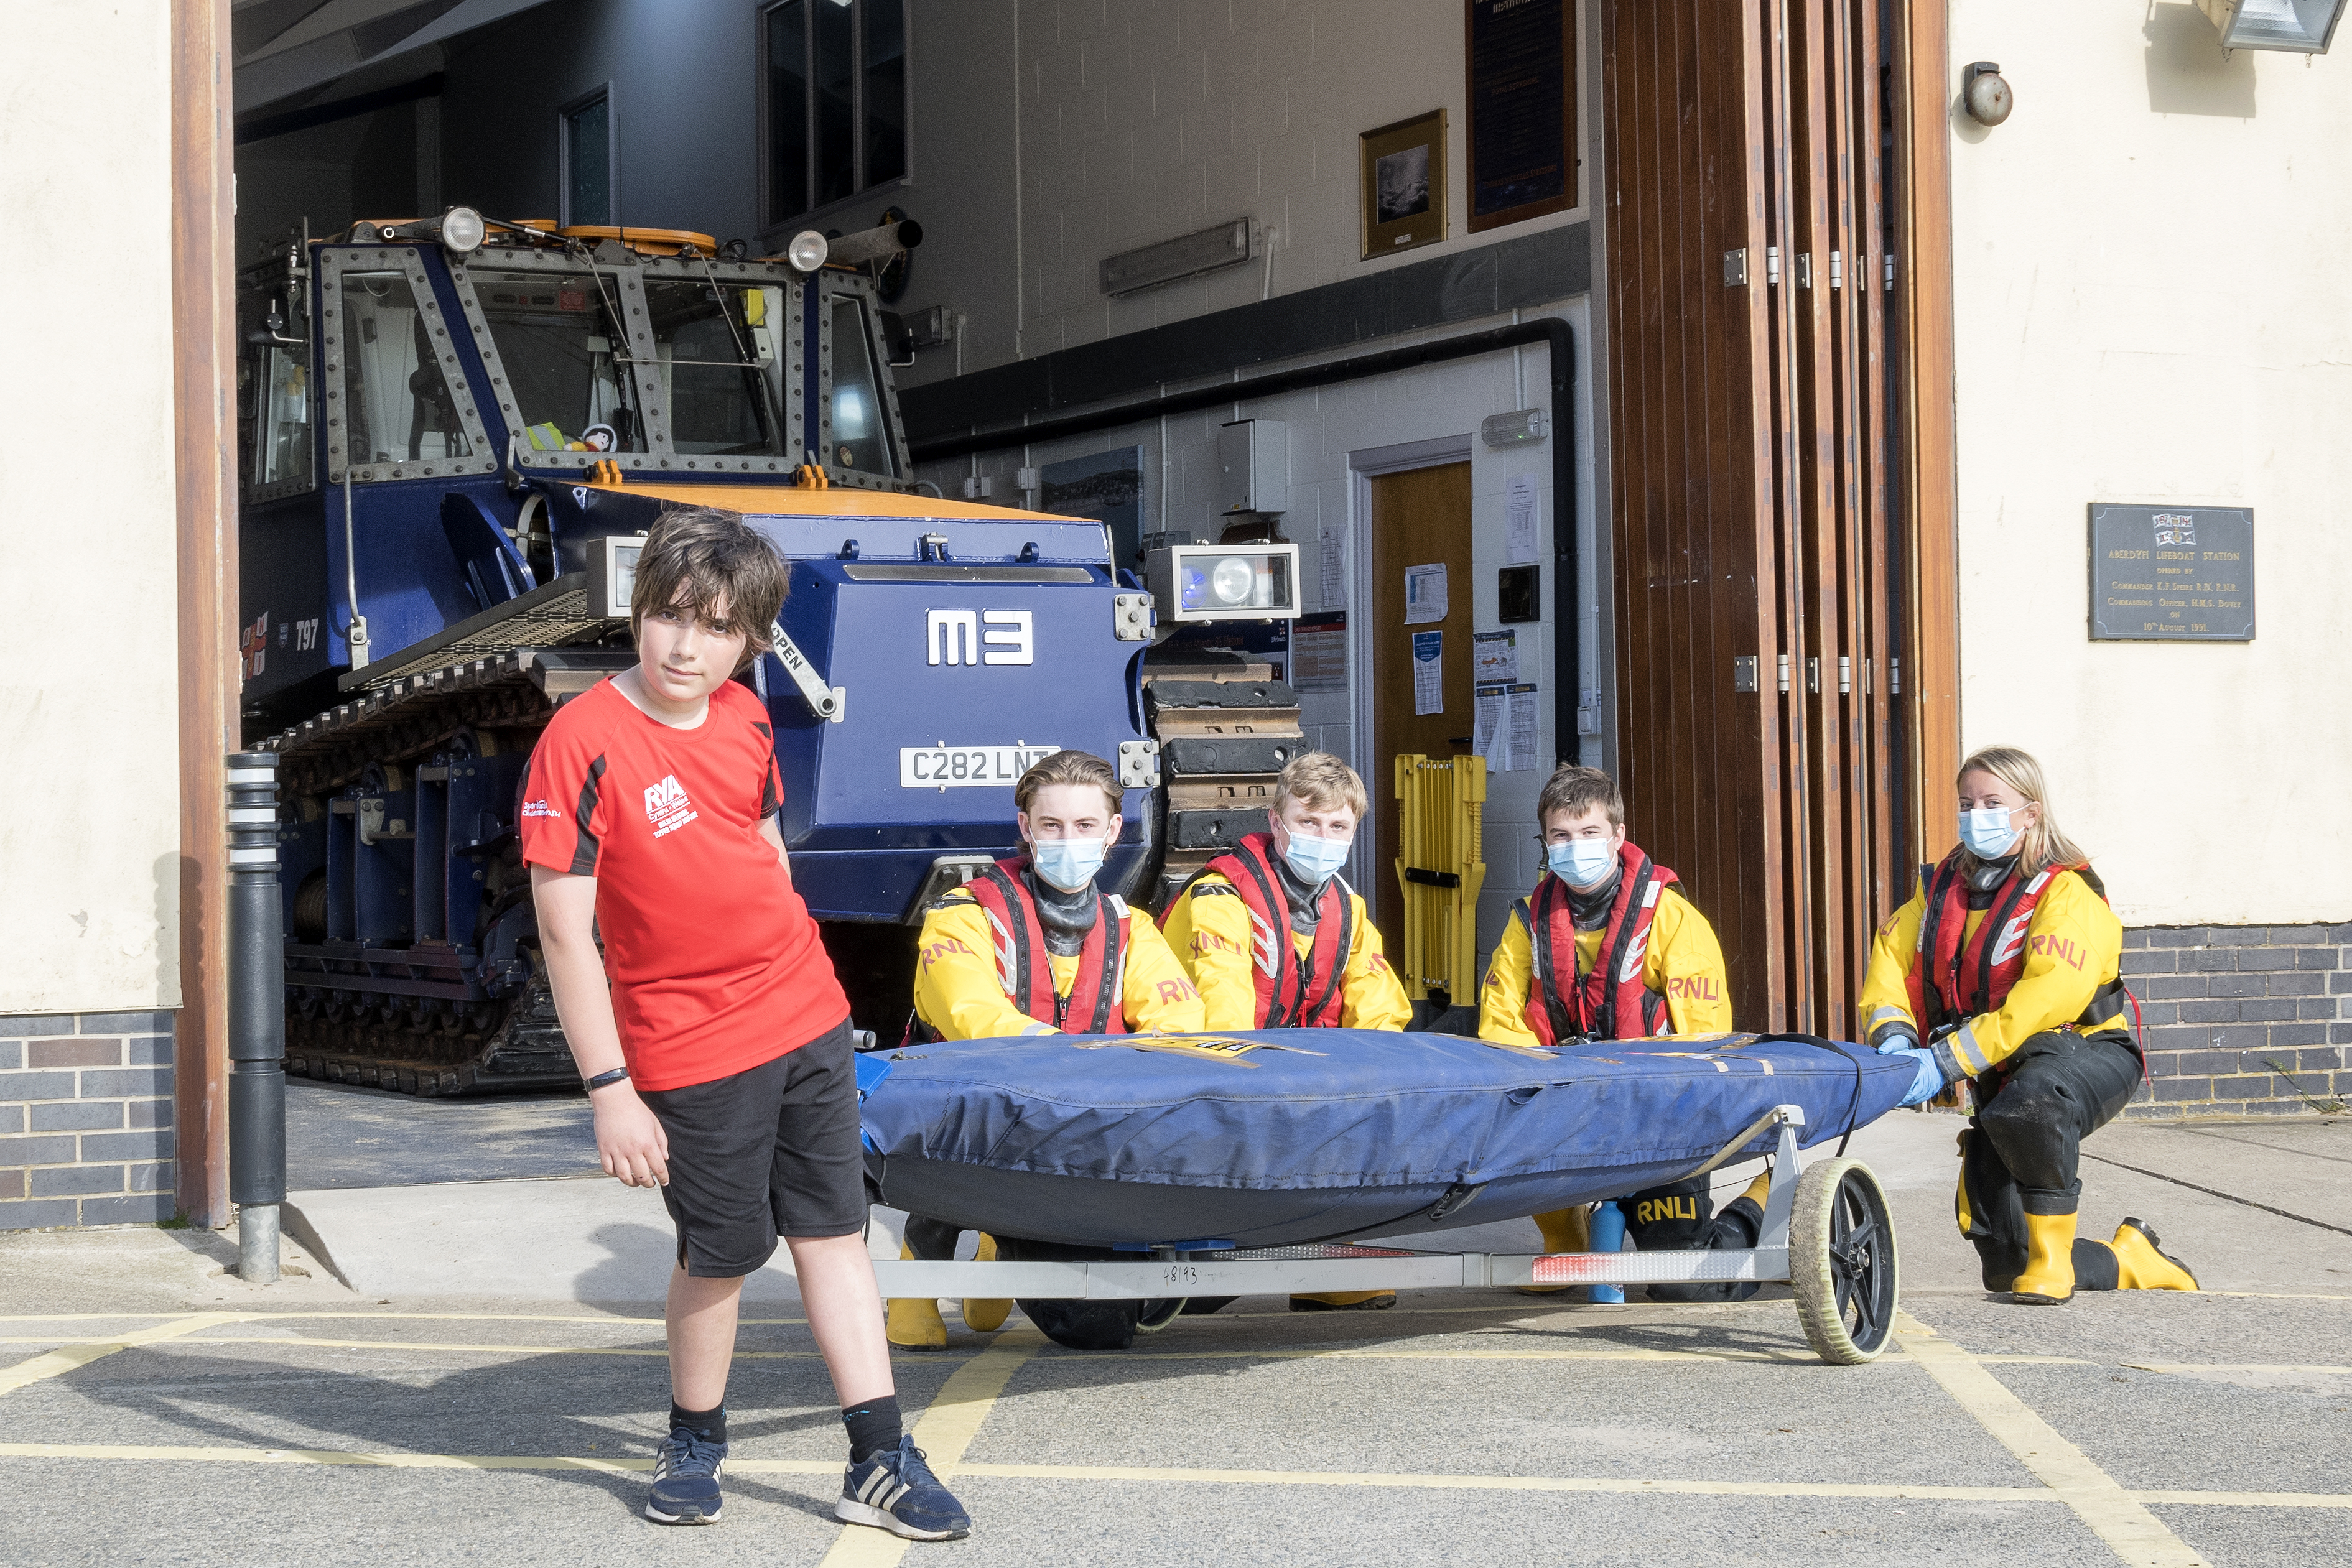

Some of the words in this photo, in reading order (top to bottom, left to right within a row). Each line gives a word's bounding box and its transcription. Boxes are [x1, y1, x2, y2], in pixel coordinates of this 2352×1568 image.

[2108, 550, 2149, 559] ABERDYFI
[2156, 551, 2195, 560] LIFEBOAT
[2203, 551, 2240, 561] STATION
[296, 618, 319, 651] T97
[771, 627, 803, 670] OPEN
[927, 610, 1034, 666] M3
[914, 751, 988, 780] C282
[644, 774, 686, 813] RYA
[648, 807, 670, 820] Cymru
[922, 939, 975, 976] RNL
[2031, 934, 2086, 972] RNLI
[1668, 977, 1719, 1002] RNLI
[1637, 1196, 1697, 1225] RNLI
